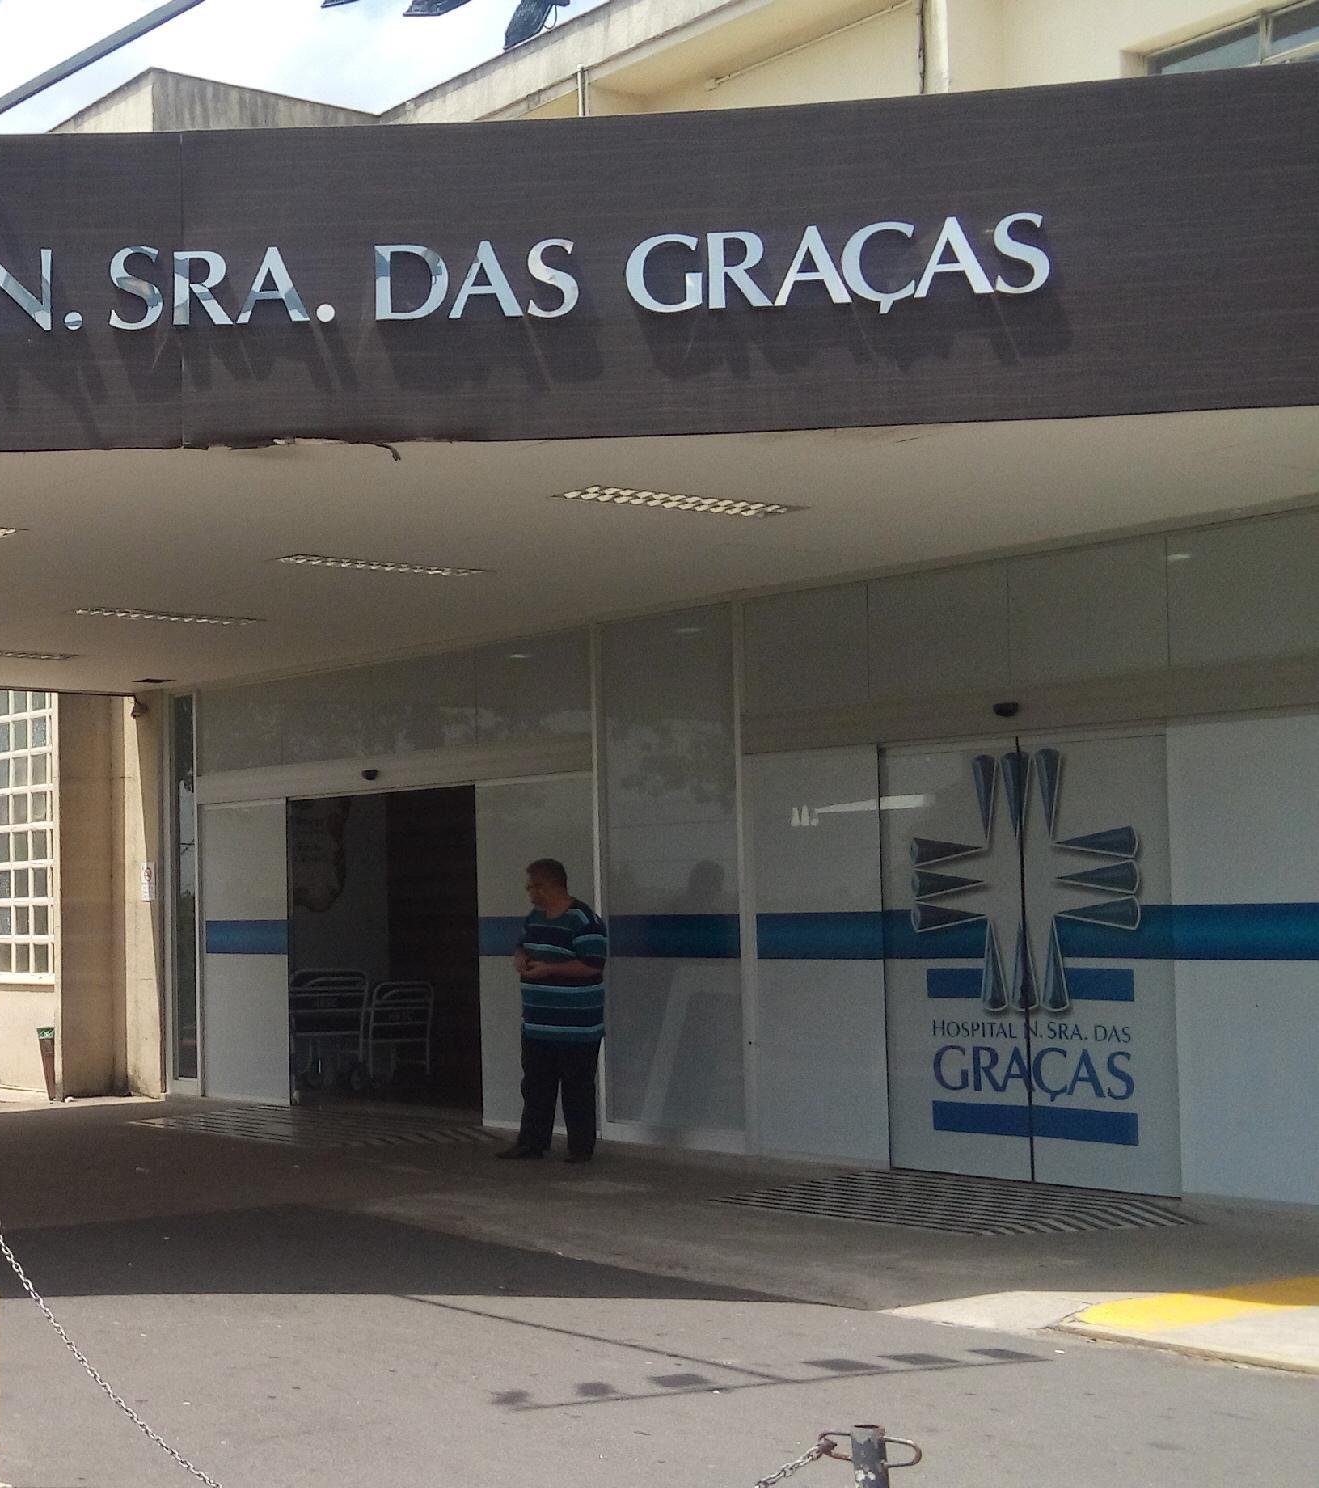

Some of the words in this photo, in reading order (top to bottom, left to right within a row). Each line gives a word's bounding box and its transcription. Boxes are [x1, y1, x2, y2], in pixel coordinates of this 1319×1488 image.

[109, 244, 337, 332] SRA.
[374, 238, 580, 321] DAS
[625, 212, 1051, 314] GRAÇAS
[932, 1019, 1017, 1039] HOSPITAL
[1047, 1021, 1088, 1041] SRA.
[1094, 1025, 1132, 1043] DAS
[932, 1044, 1135, 1102] GRAÇAS
